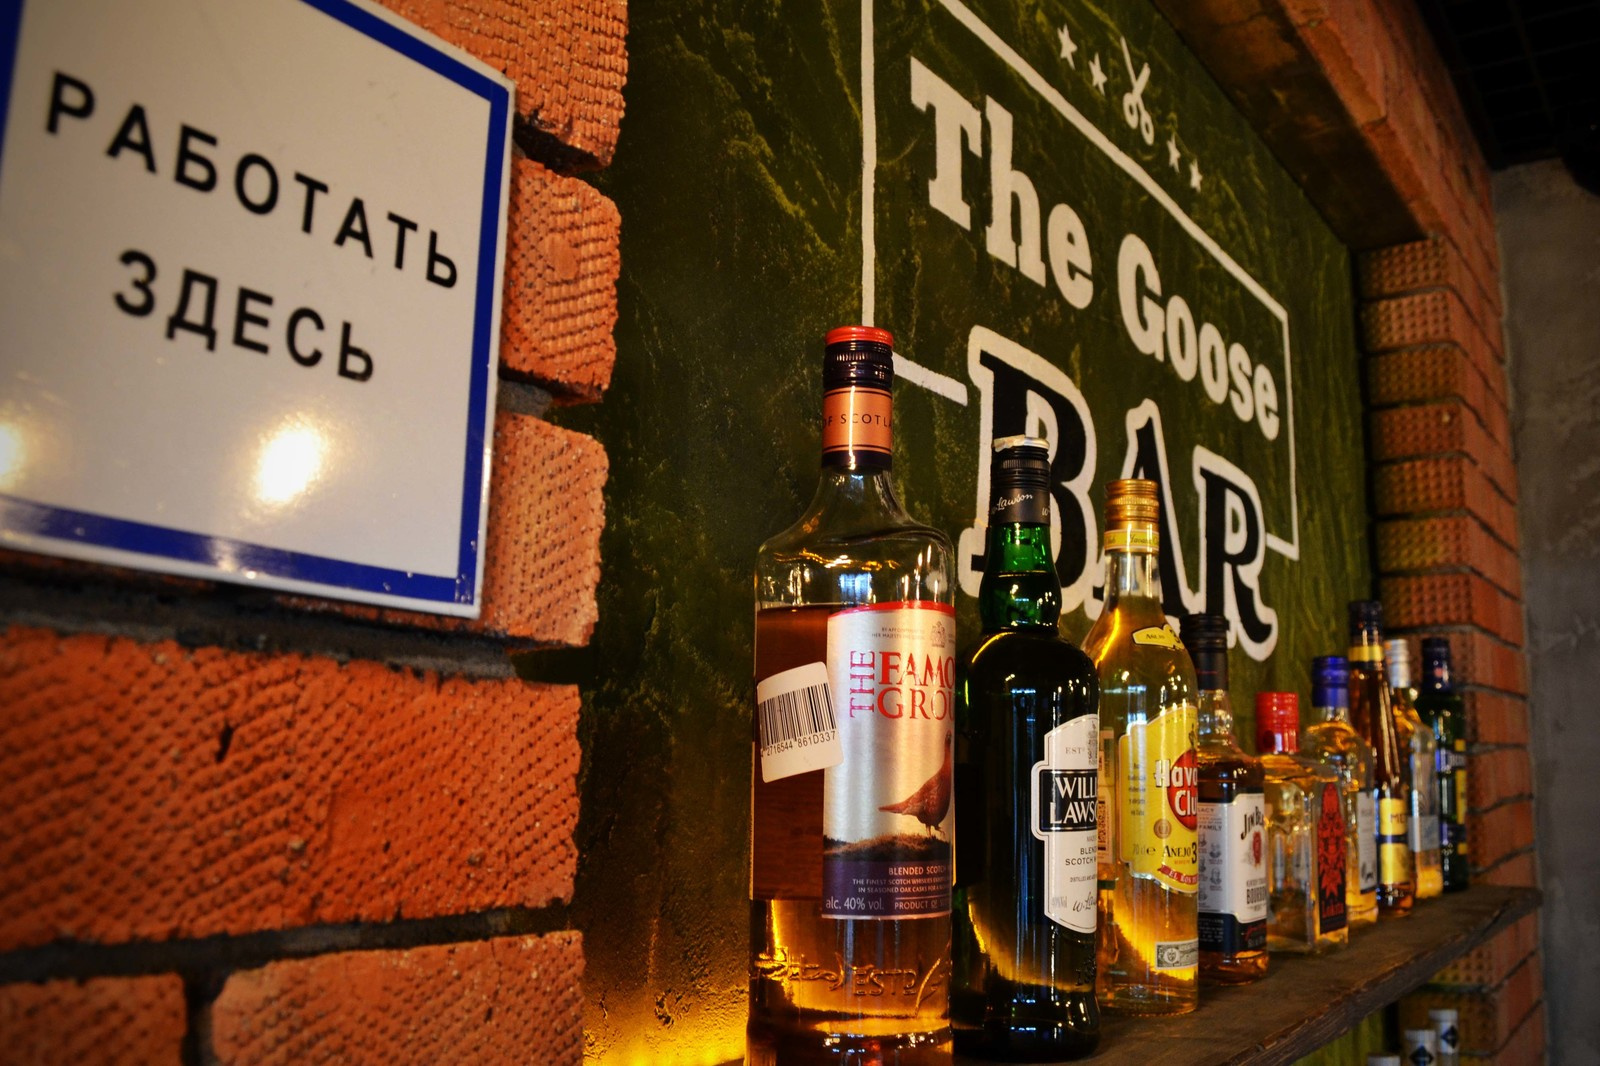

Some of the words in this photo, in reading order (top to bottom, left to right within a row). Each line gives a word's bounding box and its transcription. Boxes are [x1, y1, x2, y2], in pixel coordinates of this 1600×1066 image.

[45, 70, 458, 290] РАБОТАТЬ
[911, 57, 1093, 309] The
[1117, 233, 1280, 441] Goose
[113, 249, 375, 384] ЗДЕСЬ
[958, 325, 1278, 662] BAR
[850, 650, 875, 718] THE
[825, 896, 842, 910] alc.
[843, 897, 866, 911] 40%
[868, 897, 885, 910] vol.
[888, 866, 924, 876] BLENDED
[894, 901, 929, 910] PRODUCT
